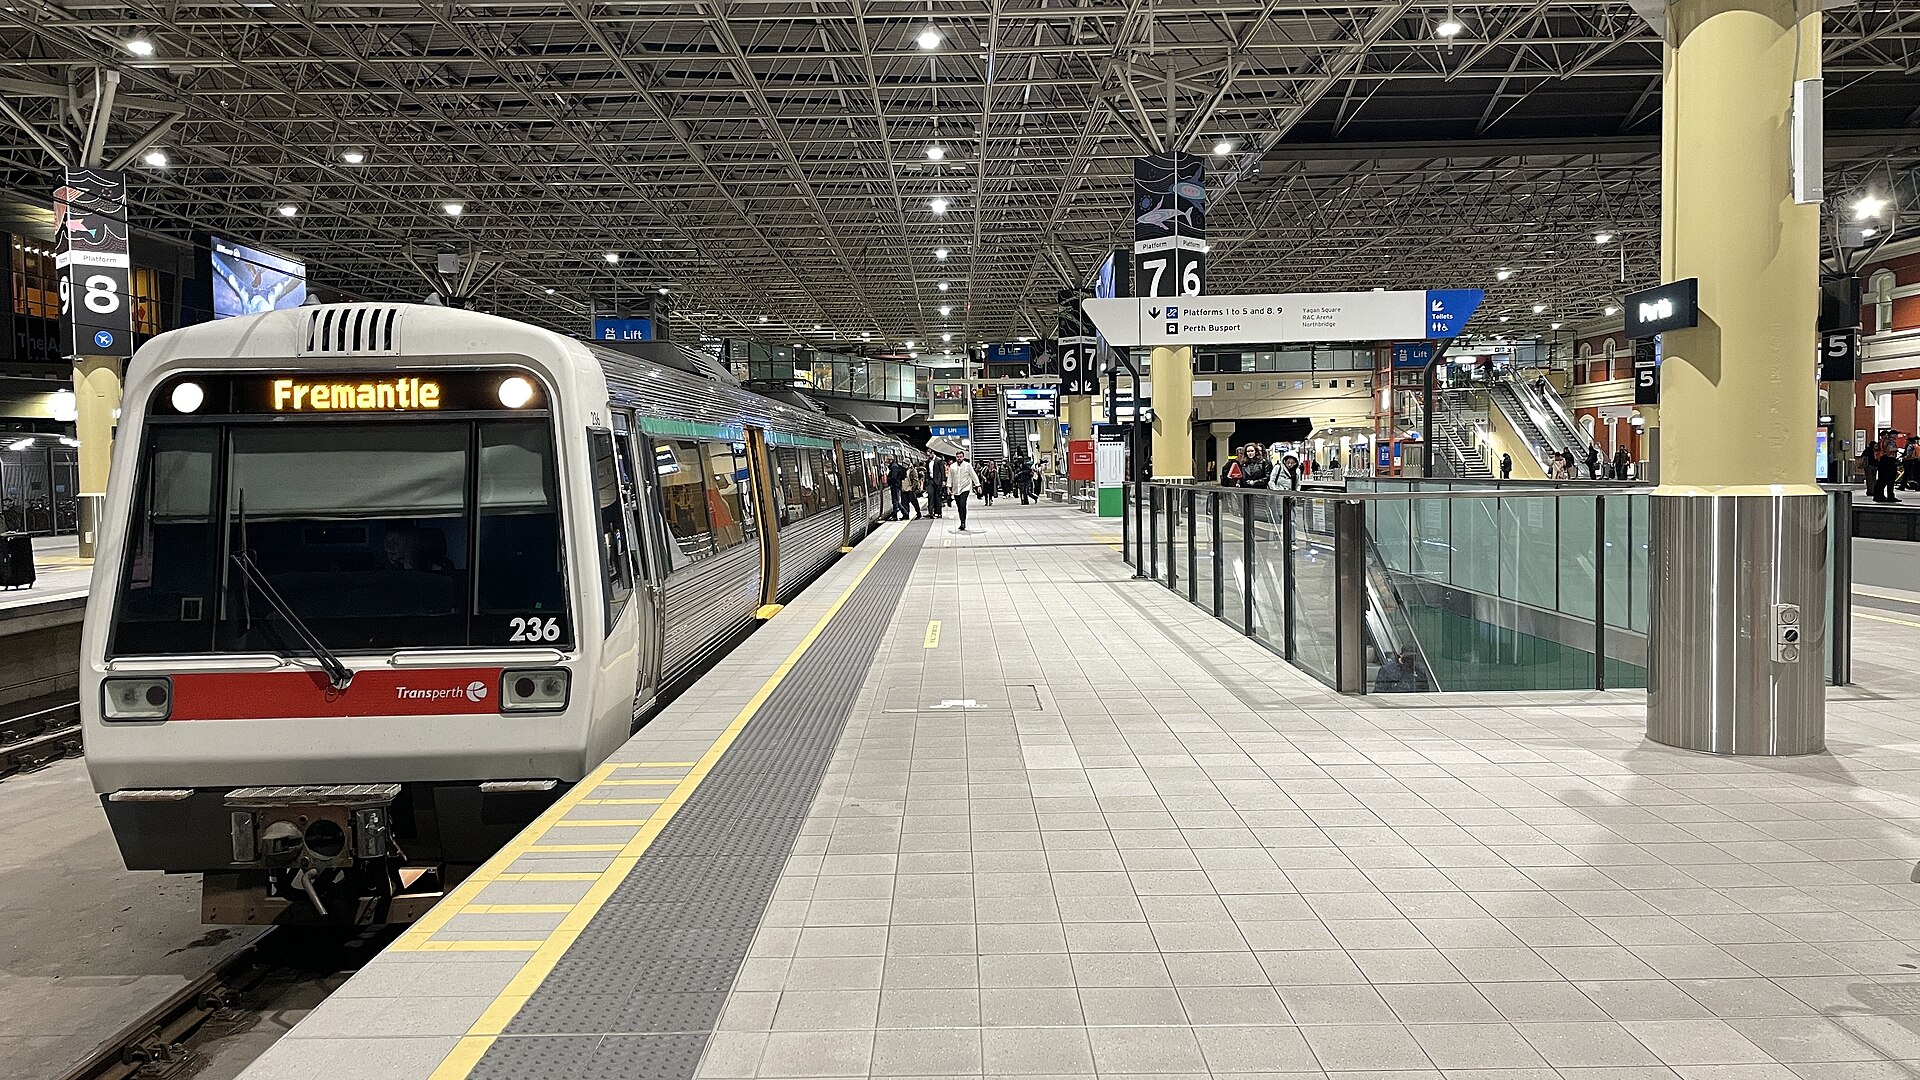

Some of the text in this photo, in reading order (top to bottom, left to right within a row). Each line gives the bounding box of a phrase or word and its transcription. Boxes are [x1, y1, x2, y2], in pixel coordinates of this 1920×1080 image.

[1142, 241, 1167, 250] Platform
[83, 255, 117, 263] Platform
[1143, 259, 1167, 297] 7
[1183, 261, 1201, 297] 6
[60, 275, 70, 315] 9
[84, 274, 120, 314] 8
[1183, 308, 1223, 316] Platforms
[1225, 308, 1229, 316] 1
[1250, 307, 1264, 315] and
[1277, 307, 1283, 315] 9
[623, 330, 642, 339] Lift
[1183, 324, 1241, 333] Perth Busport
[17, 332, 44, 351] The
[1828, 335, 1848, 357] 5
[1062, 349, 1077, 372] 6
[1085, 348, 1096, 371] 7
[1413, 350, 1428, 358] Lift
[1640, 370, 1654, 387] 5
[273, 376, 440, 411] Fremantle
[590, 411, 601, 426] 236
[509, 617, 561, 642] 236
[395, 685, 464, 701] Transperth
